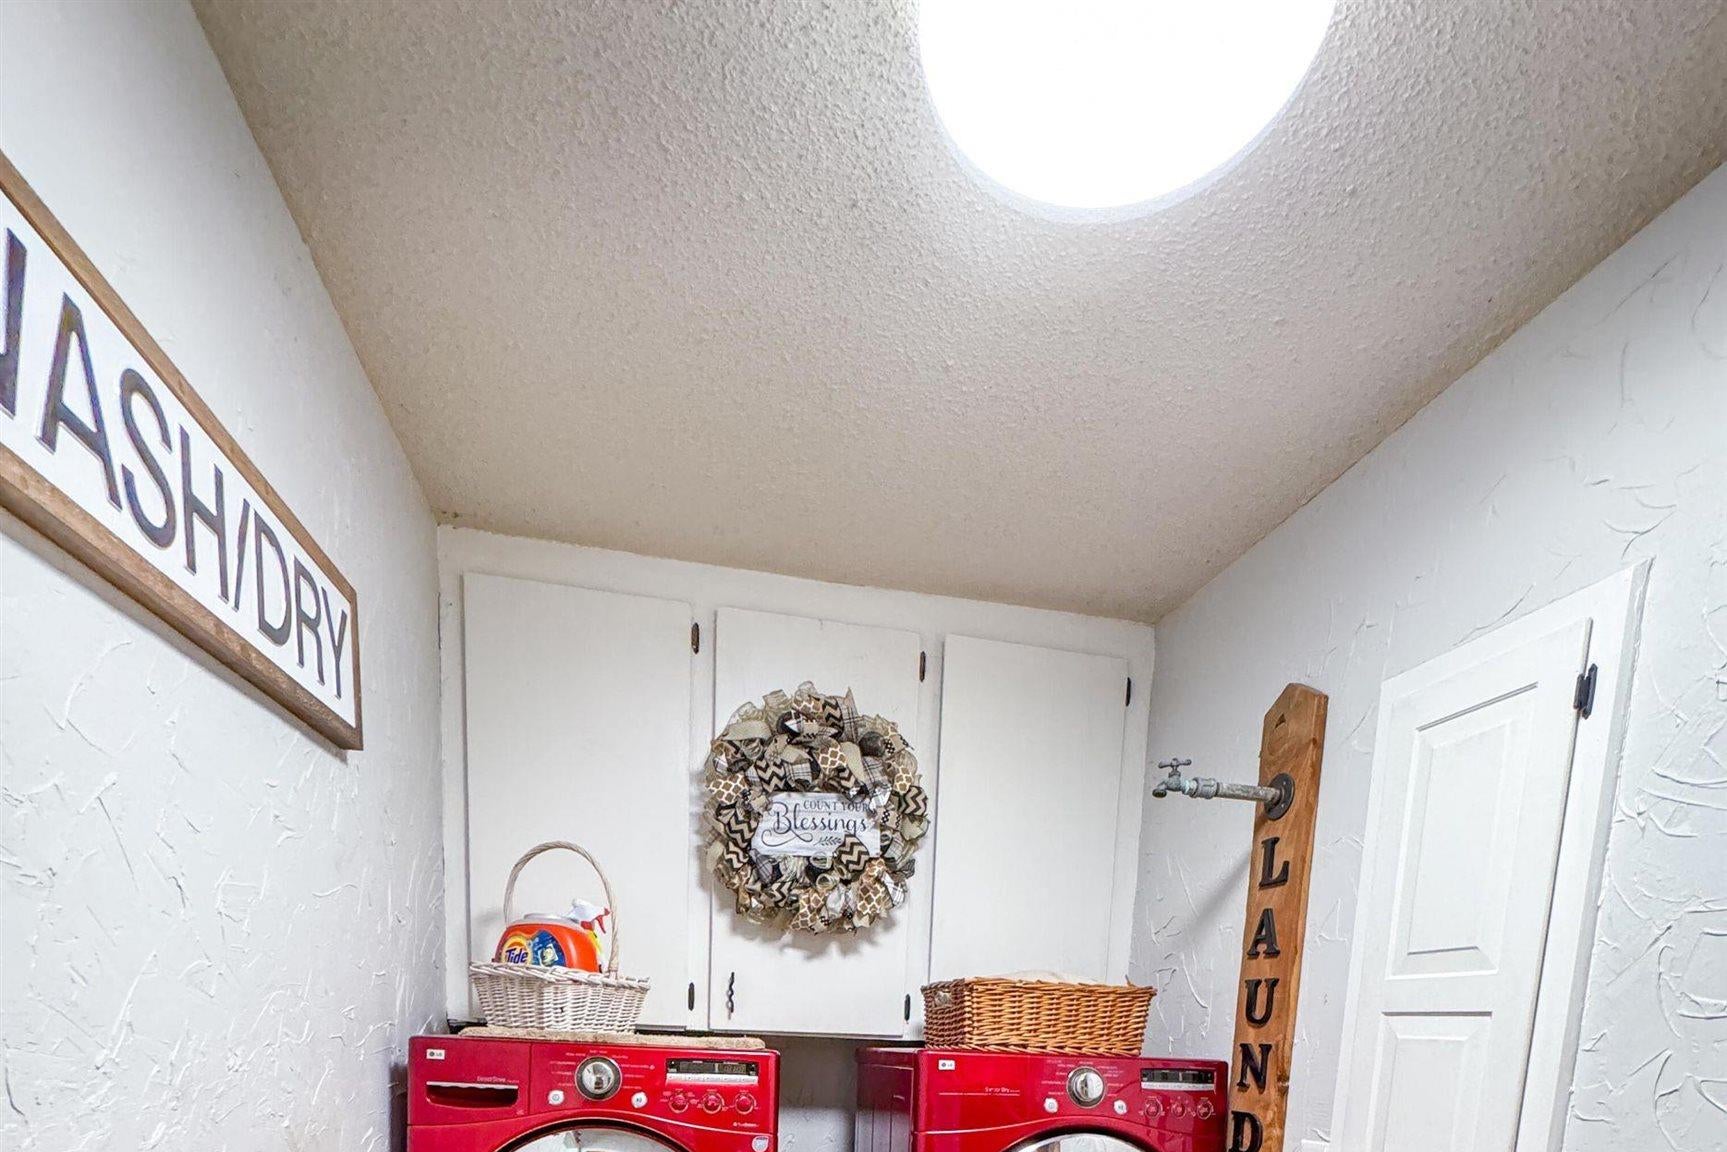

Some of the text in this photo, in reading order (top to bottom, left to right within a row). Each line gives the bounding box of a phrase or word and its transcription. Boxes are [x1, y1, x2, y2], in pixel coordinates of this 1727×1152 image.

[803, 800, 870, 812] COUNT YOUR
[762, 801, 867, 846] Blessings
[505, 947, 528, 964] Tide
